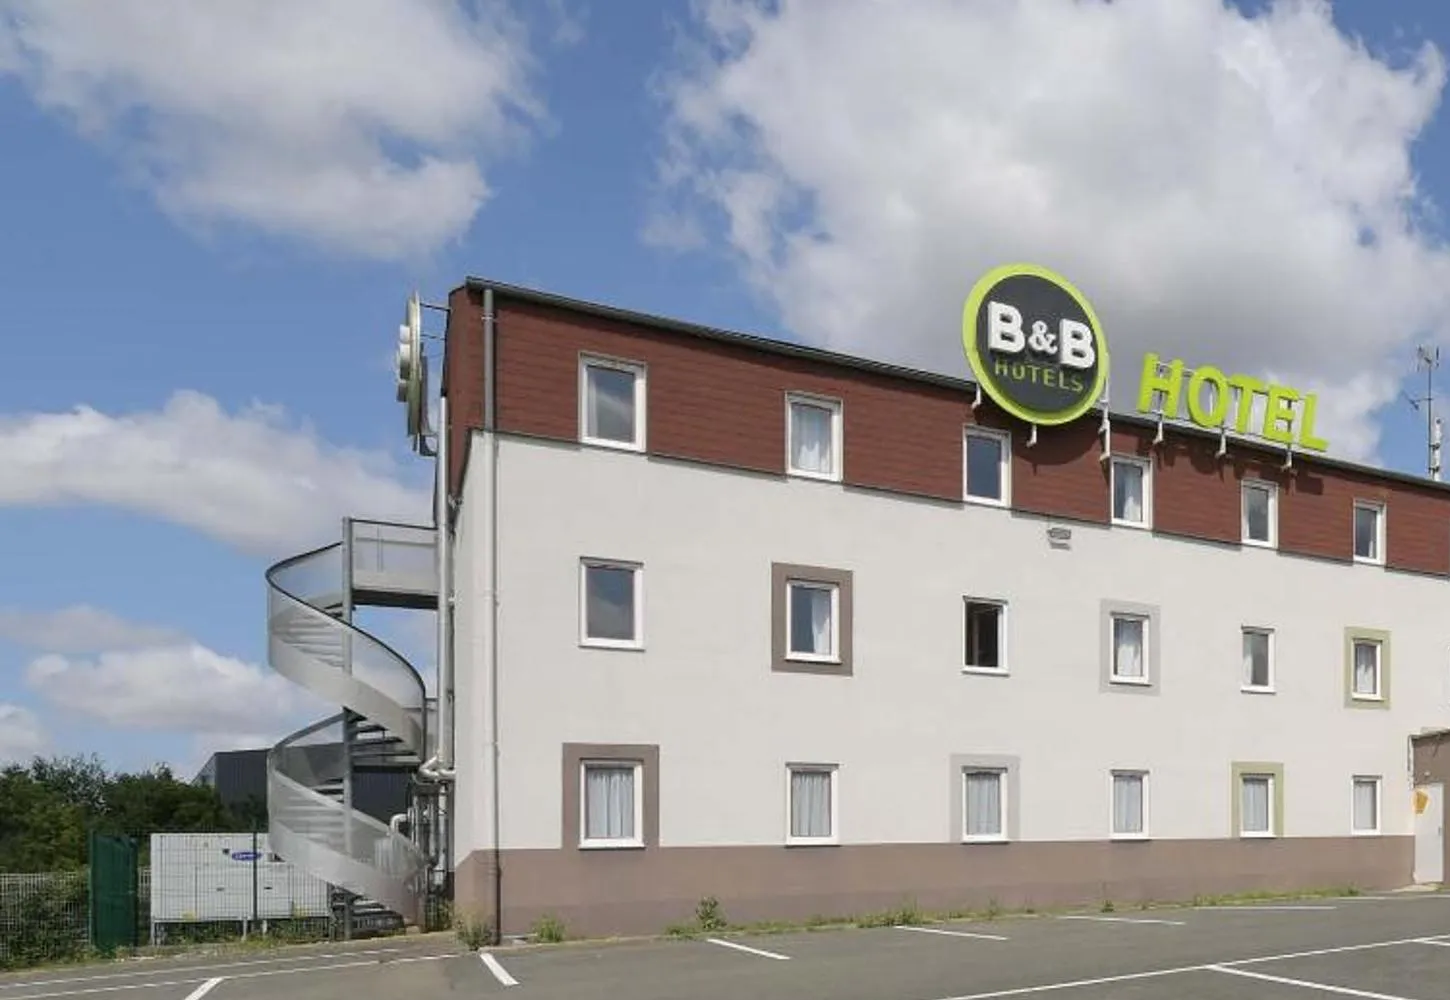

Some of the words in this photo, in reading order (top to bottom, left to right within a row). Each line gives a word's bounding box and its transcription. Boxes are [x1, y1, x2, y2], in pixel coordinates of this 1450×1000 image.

[987, 300, 1095, 369] B&B
[994, 357, 1083, 393] HOTELS
[1137, 352, 1330, 453] HOTEL
